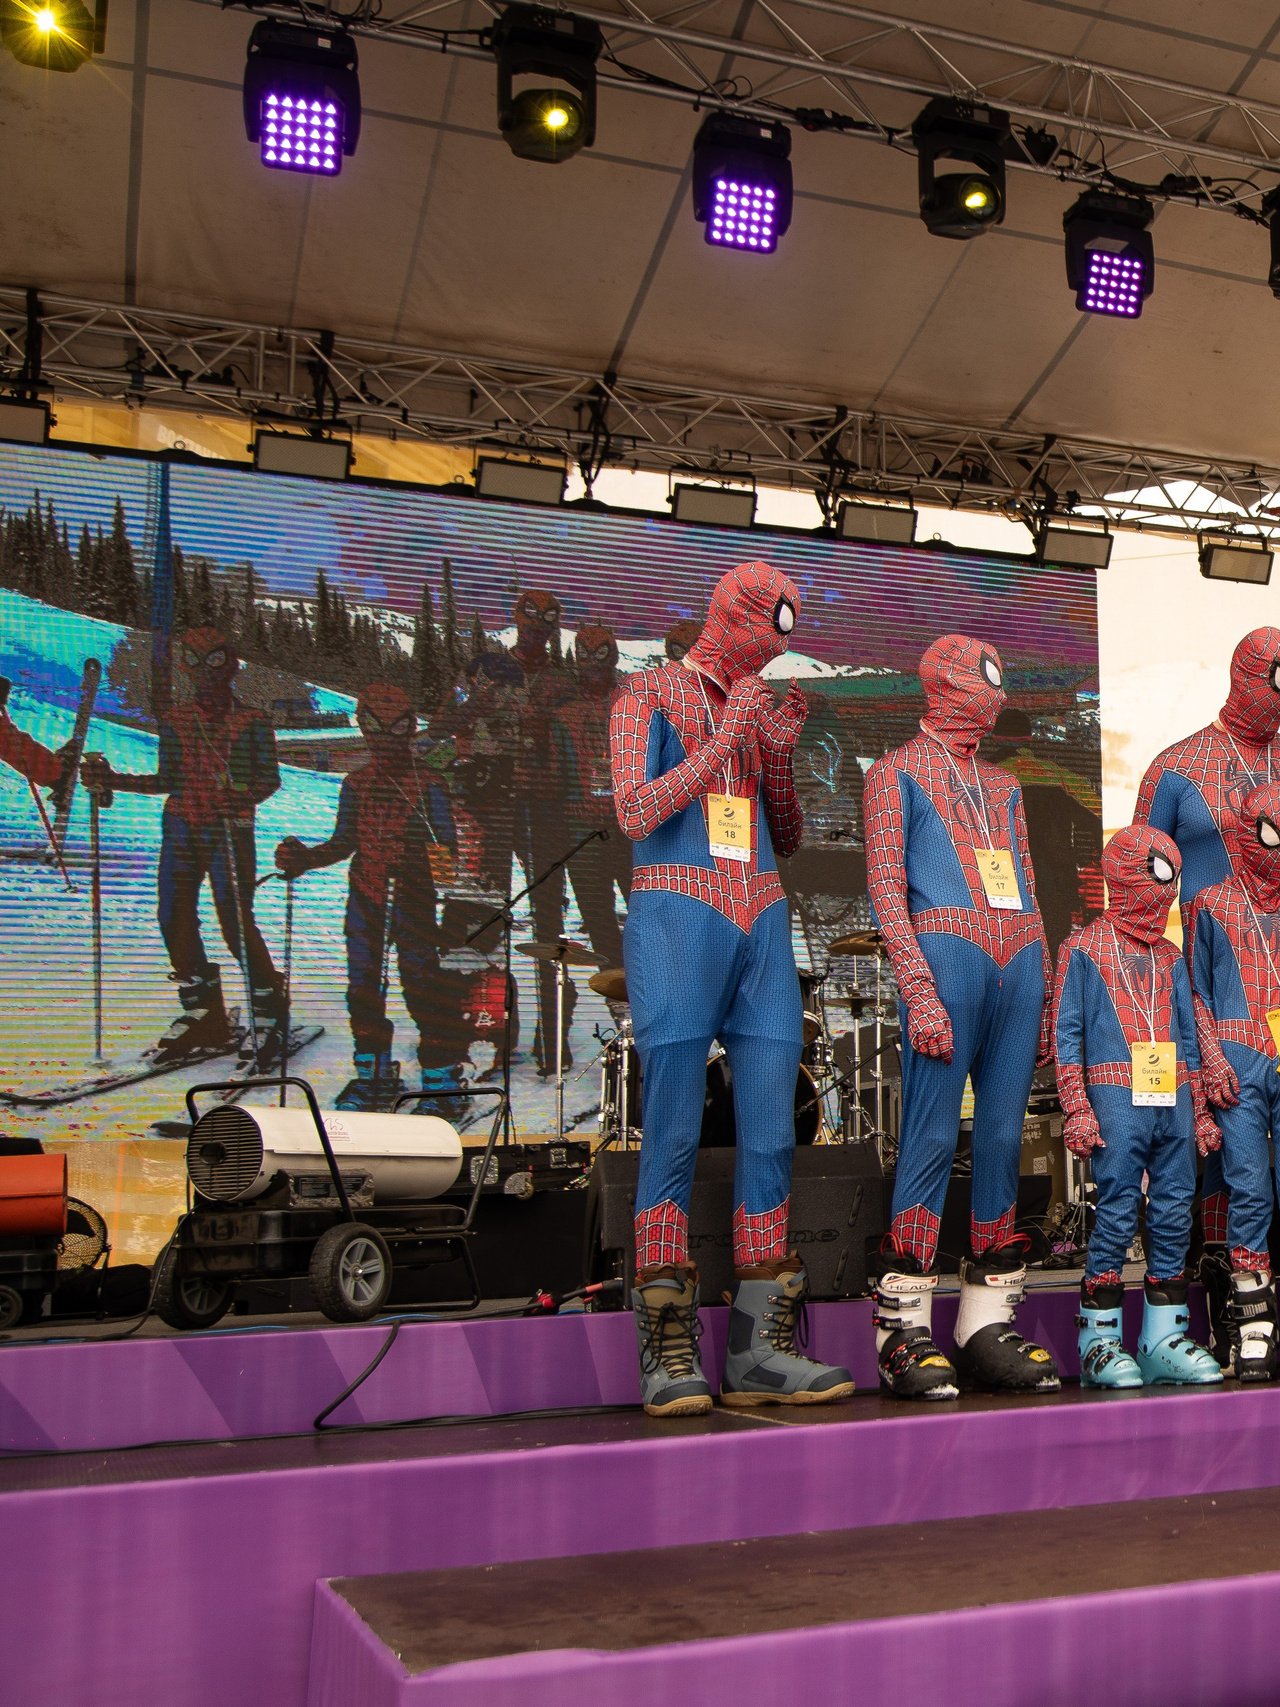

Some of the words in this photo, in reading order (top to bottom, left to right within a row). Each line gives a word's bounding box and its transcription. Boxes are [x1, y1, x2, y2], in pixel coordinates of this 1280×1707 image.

[718, 820, 742, 829] билайн
[725, 830, 736, 839] 18
[996, 882, 1005, 890] 17
[1149, 1077, 1161, 1085] 15
[1004, 1274, 1026, 1286] HEA
